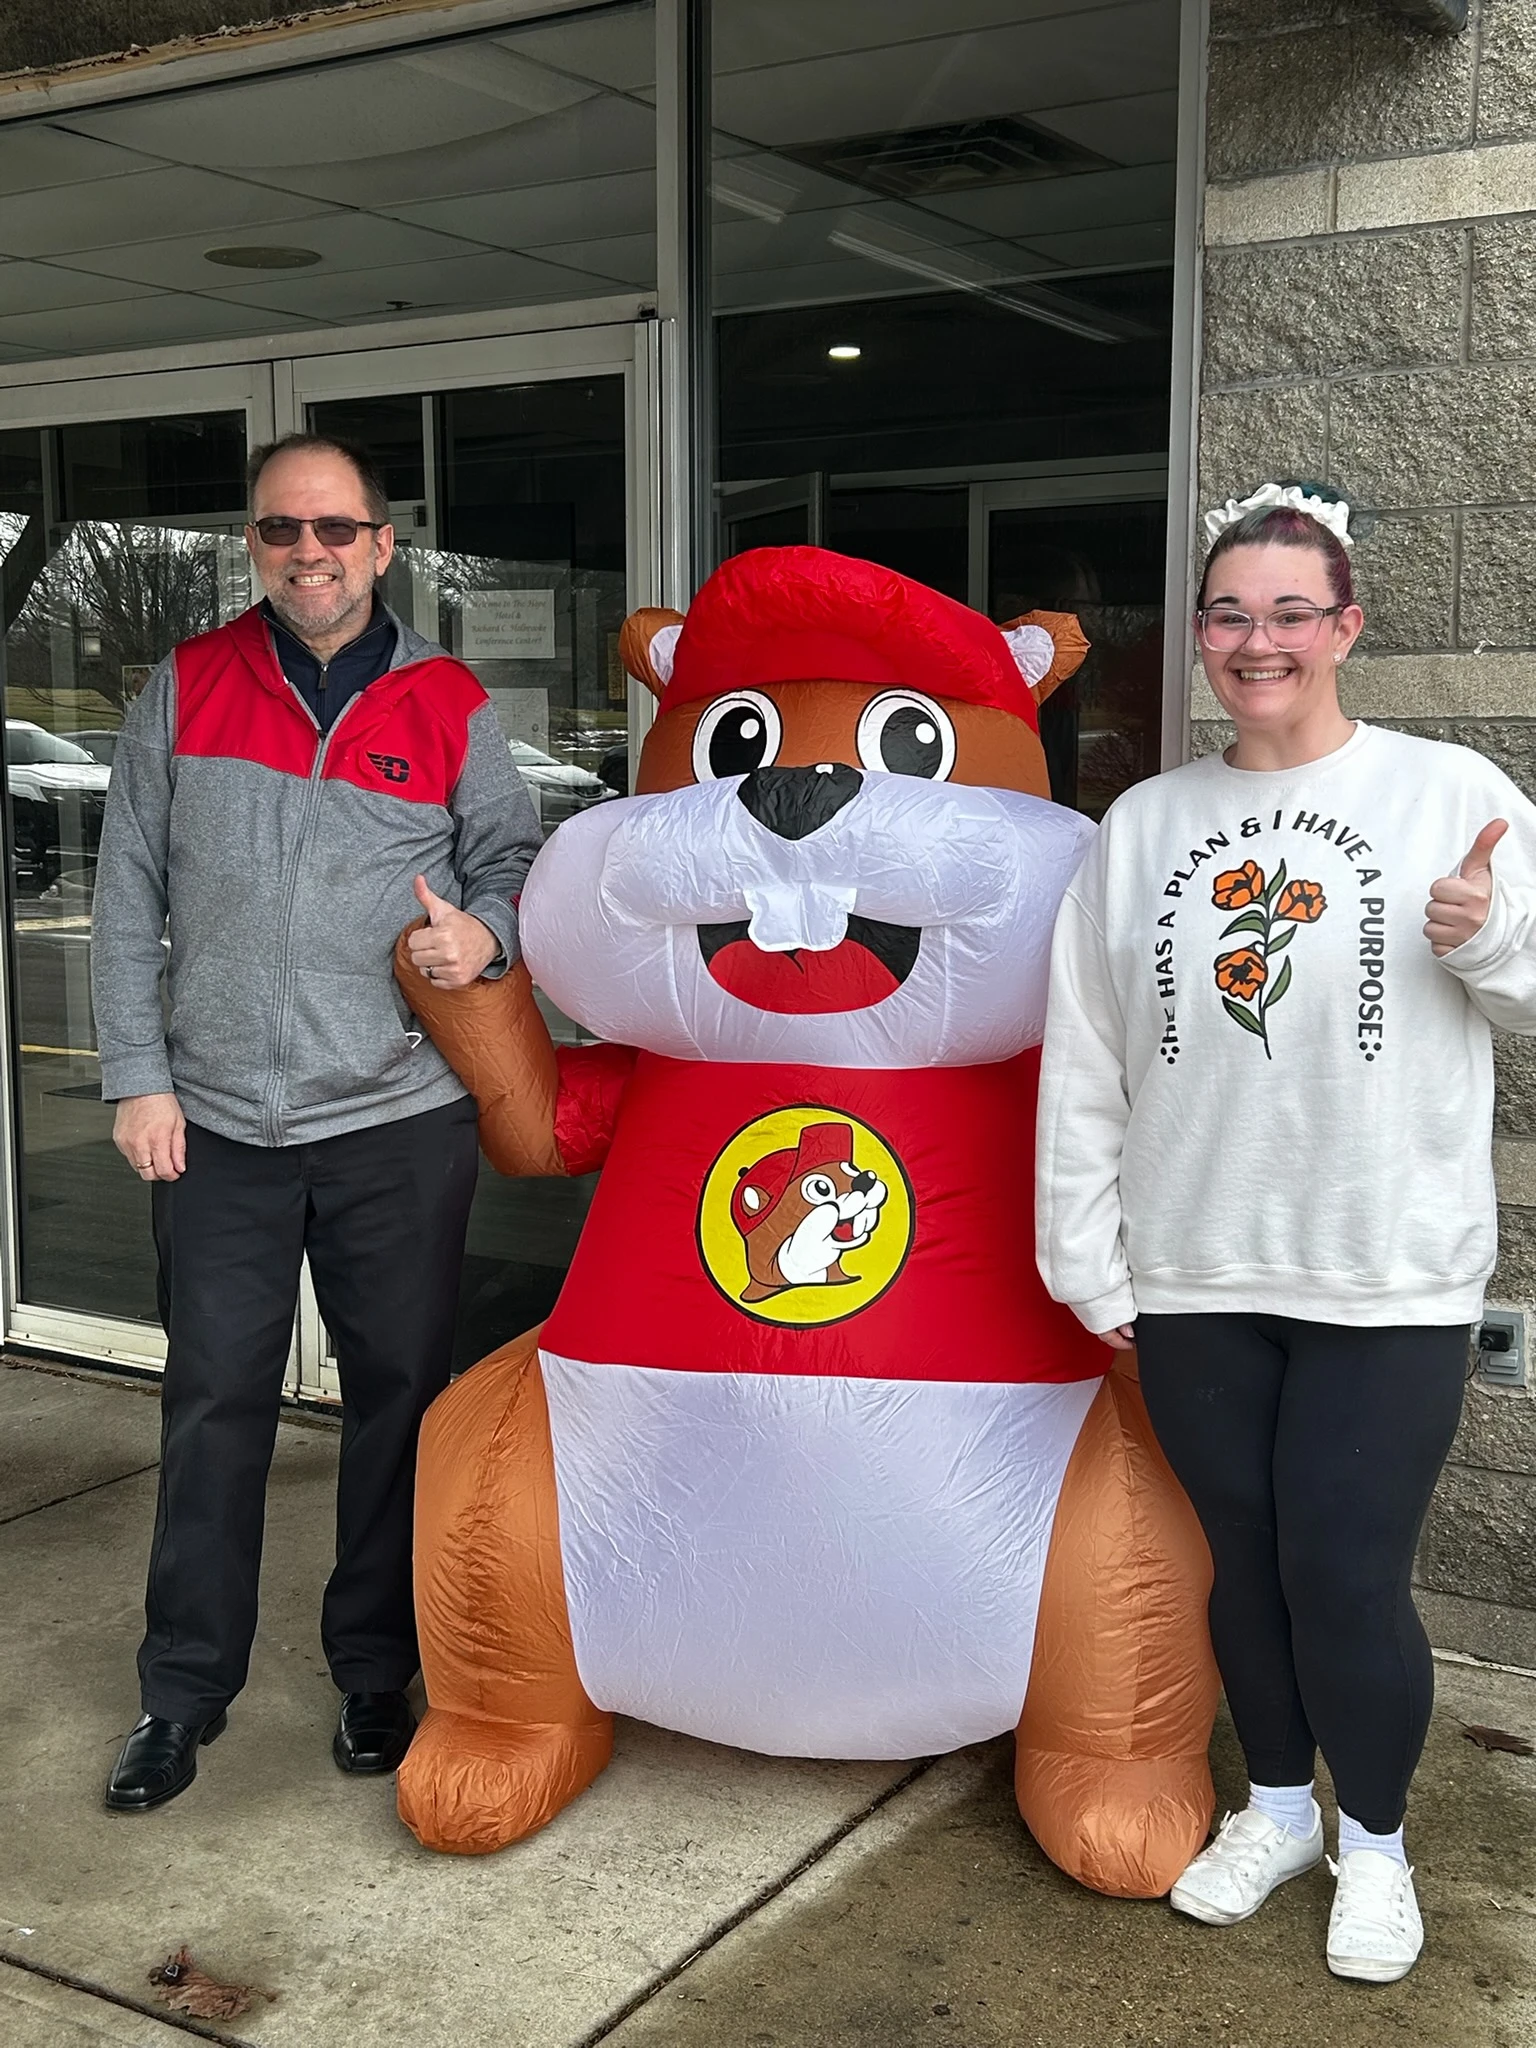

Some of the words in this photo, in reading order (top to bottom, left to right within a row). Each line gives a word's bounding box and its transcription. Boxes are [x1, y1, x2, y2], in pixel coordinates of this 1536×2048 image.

[472, 624, 500, 632] Richard
[475, 636, 514, 647] Conference
[1240, 817, 1262, 838] &
[1272, 809, 1283, 830] I
[1291, 810, 1373, 862] HAVE
[1163, 831, 1231, 898] PLAN
[1356, 868, 1383, 887] A
[1157, 910, 1177, 928] A
[1155, 938, 1176, 998] HAS
[1358, 897, 1385, 1039] PURPOSE
